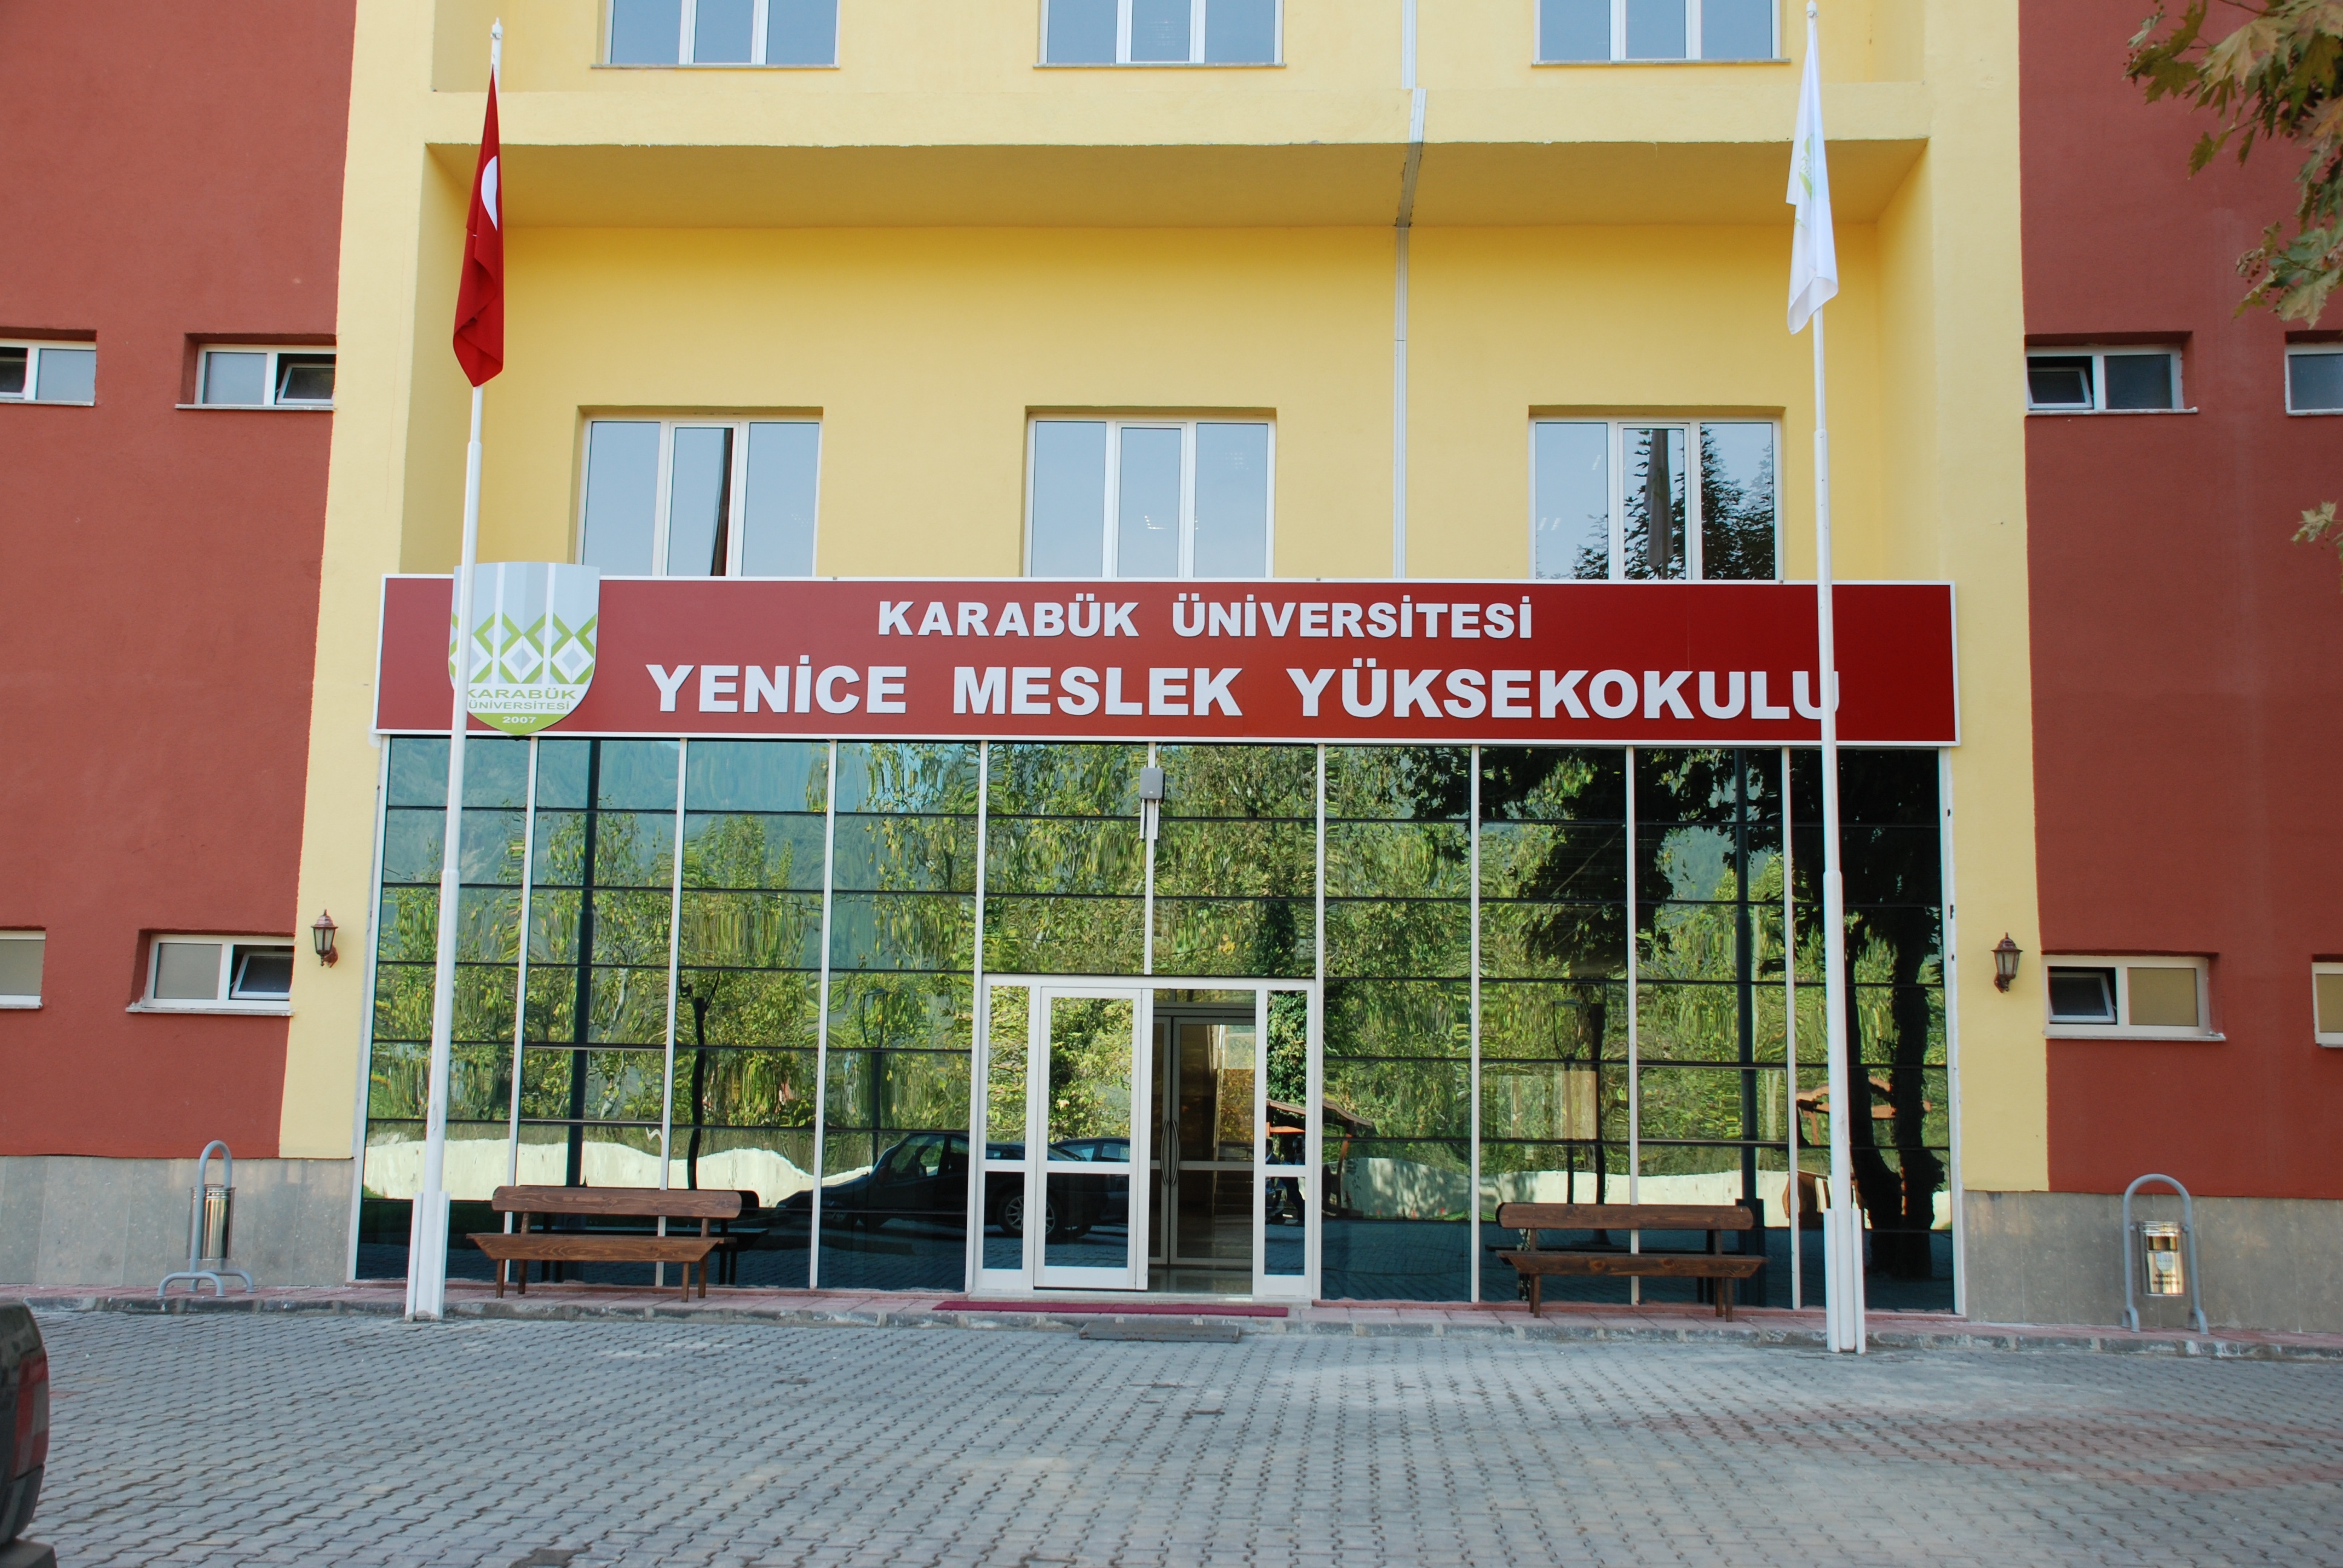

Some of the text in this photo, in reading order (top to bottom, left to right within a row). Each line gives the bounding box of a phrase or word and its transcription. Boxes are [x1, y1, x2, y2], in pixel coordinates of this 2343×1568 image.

[878, 592, 1531, 638] KARABÜK ÜNİVERSİTESİ
[469, 701, 569, 710] ÜNİVERSİTESİ
[646, 655, 1839, 720] YENİCE MESLEK YÜKSEKOKULU
